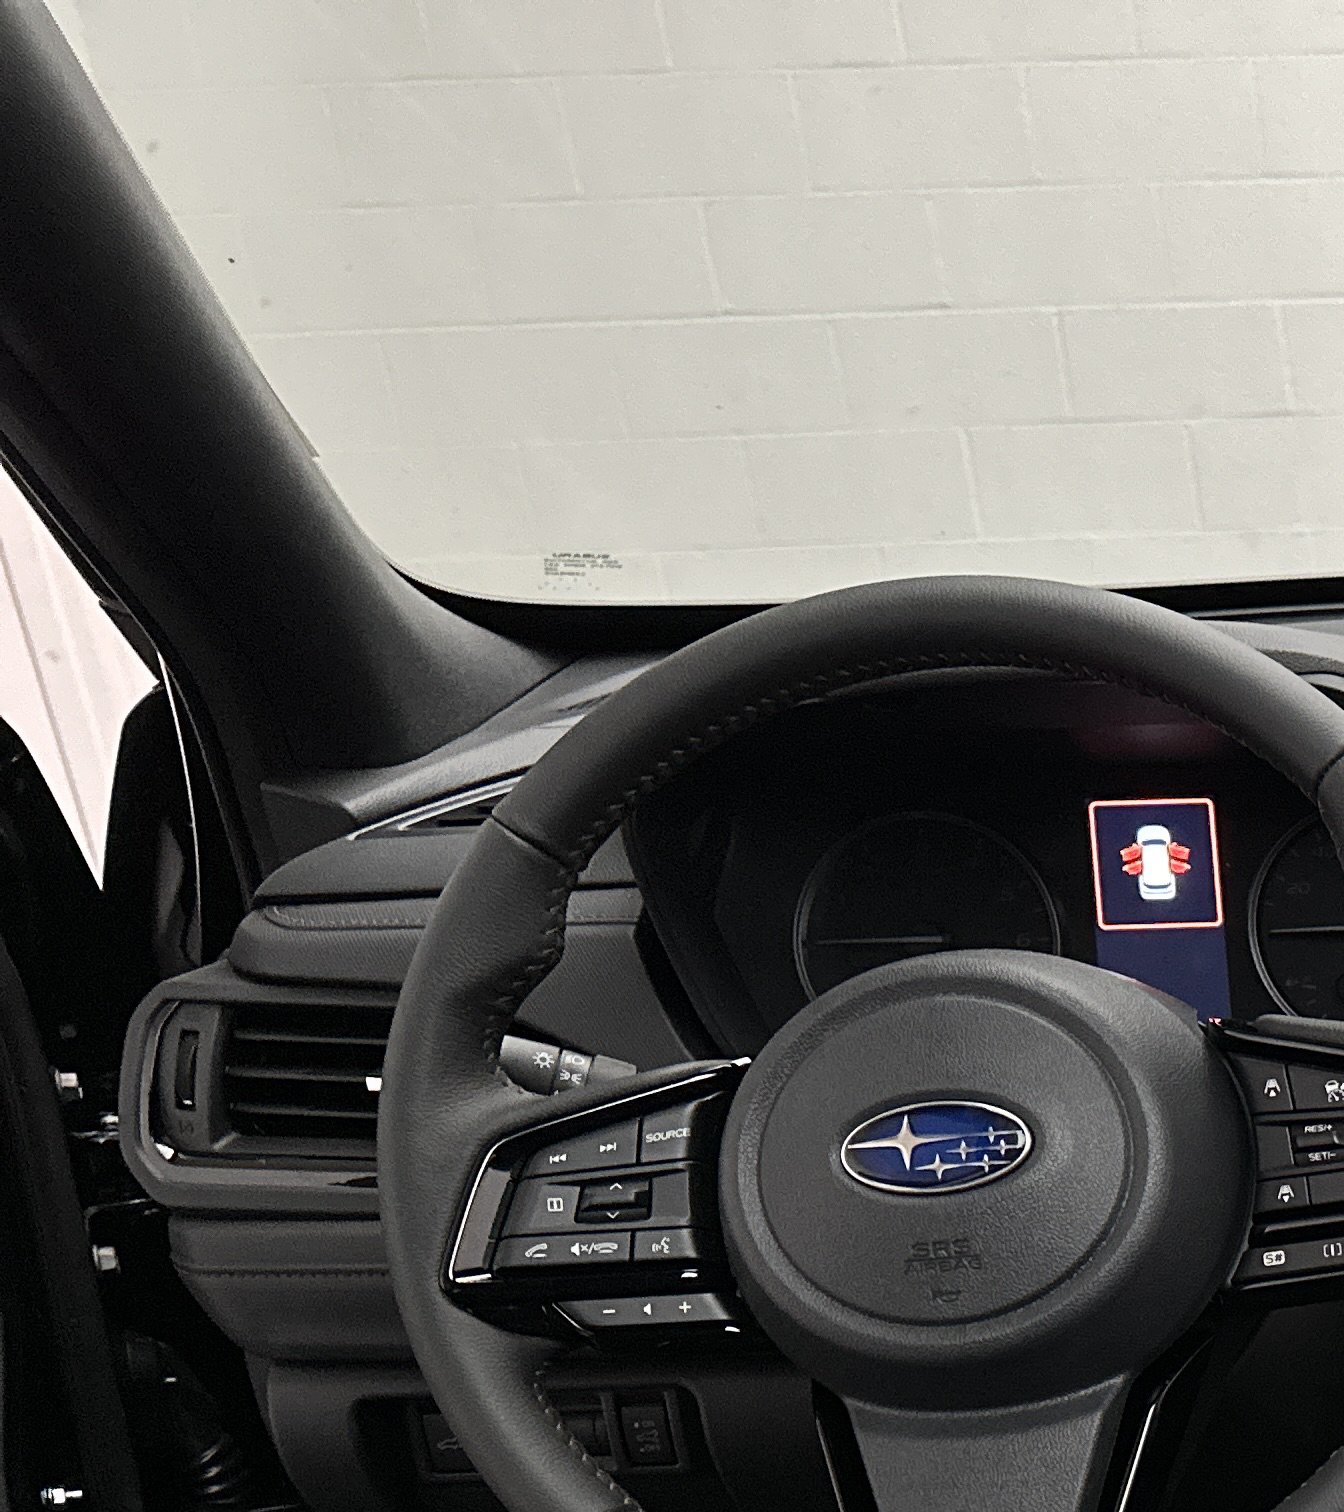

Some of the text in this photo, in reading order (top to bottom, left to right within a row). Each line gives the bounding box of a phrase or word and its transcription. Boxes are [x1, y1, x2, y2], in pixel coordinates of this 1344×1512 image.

[646, 1127, 691, 1143] SOURCE
[1304, 1124, 1333, 1133] RES/+
[910, 1238, 972, 1258] SRS
